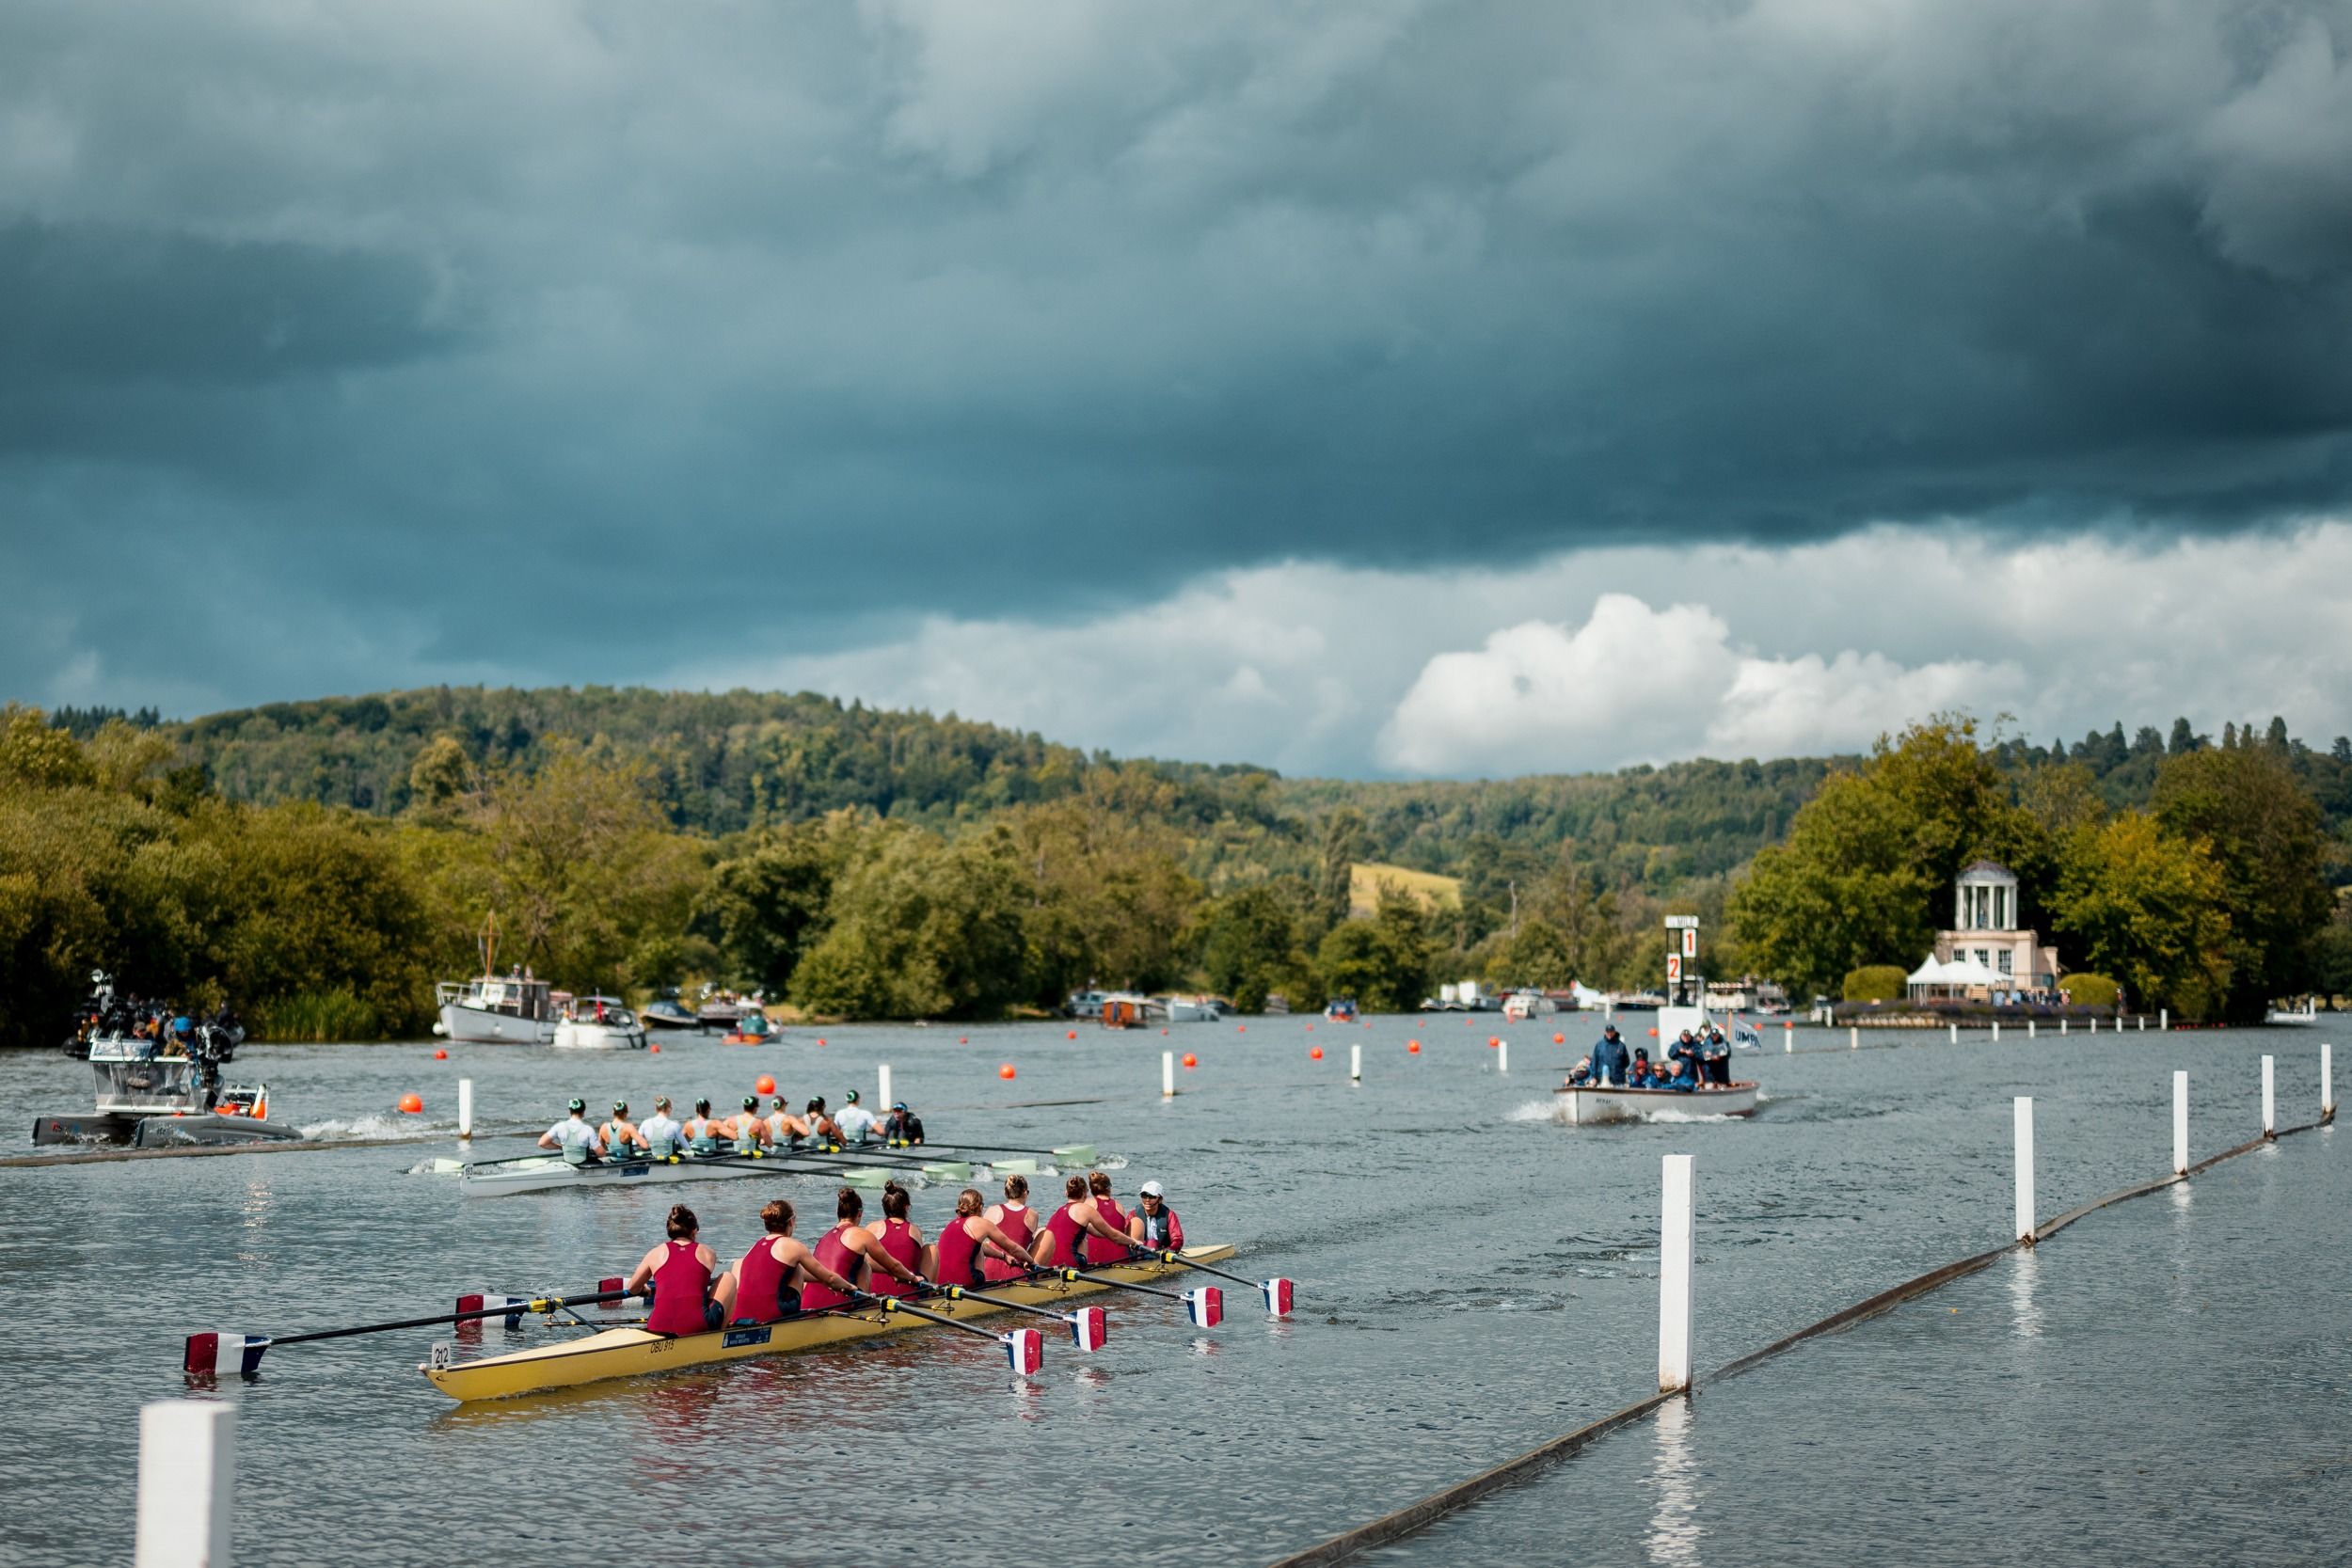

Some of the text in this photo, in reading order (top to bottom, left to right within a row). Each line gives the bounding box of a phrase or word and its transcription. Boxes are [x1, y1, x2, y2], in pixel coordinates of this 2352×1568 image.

[1687, 933, 1692, 952] 1
[1670, 958, 1679, 978] 2
[663, 1339, 675, 1352] 915
[435, 1347, 449, 1364] 212
